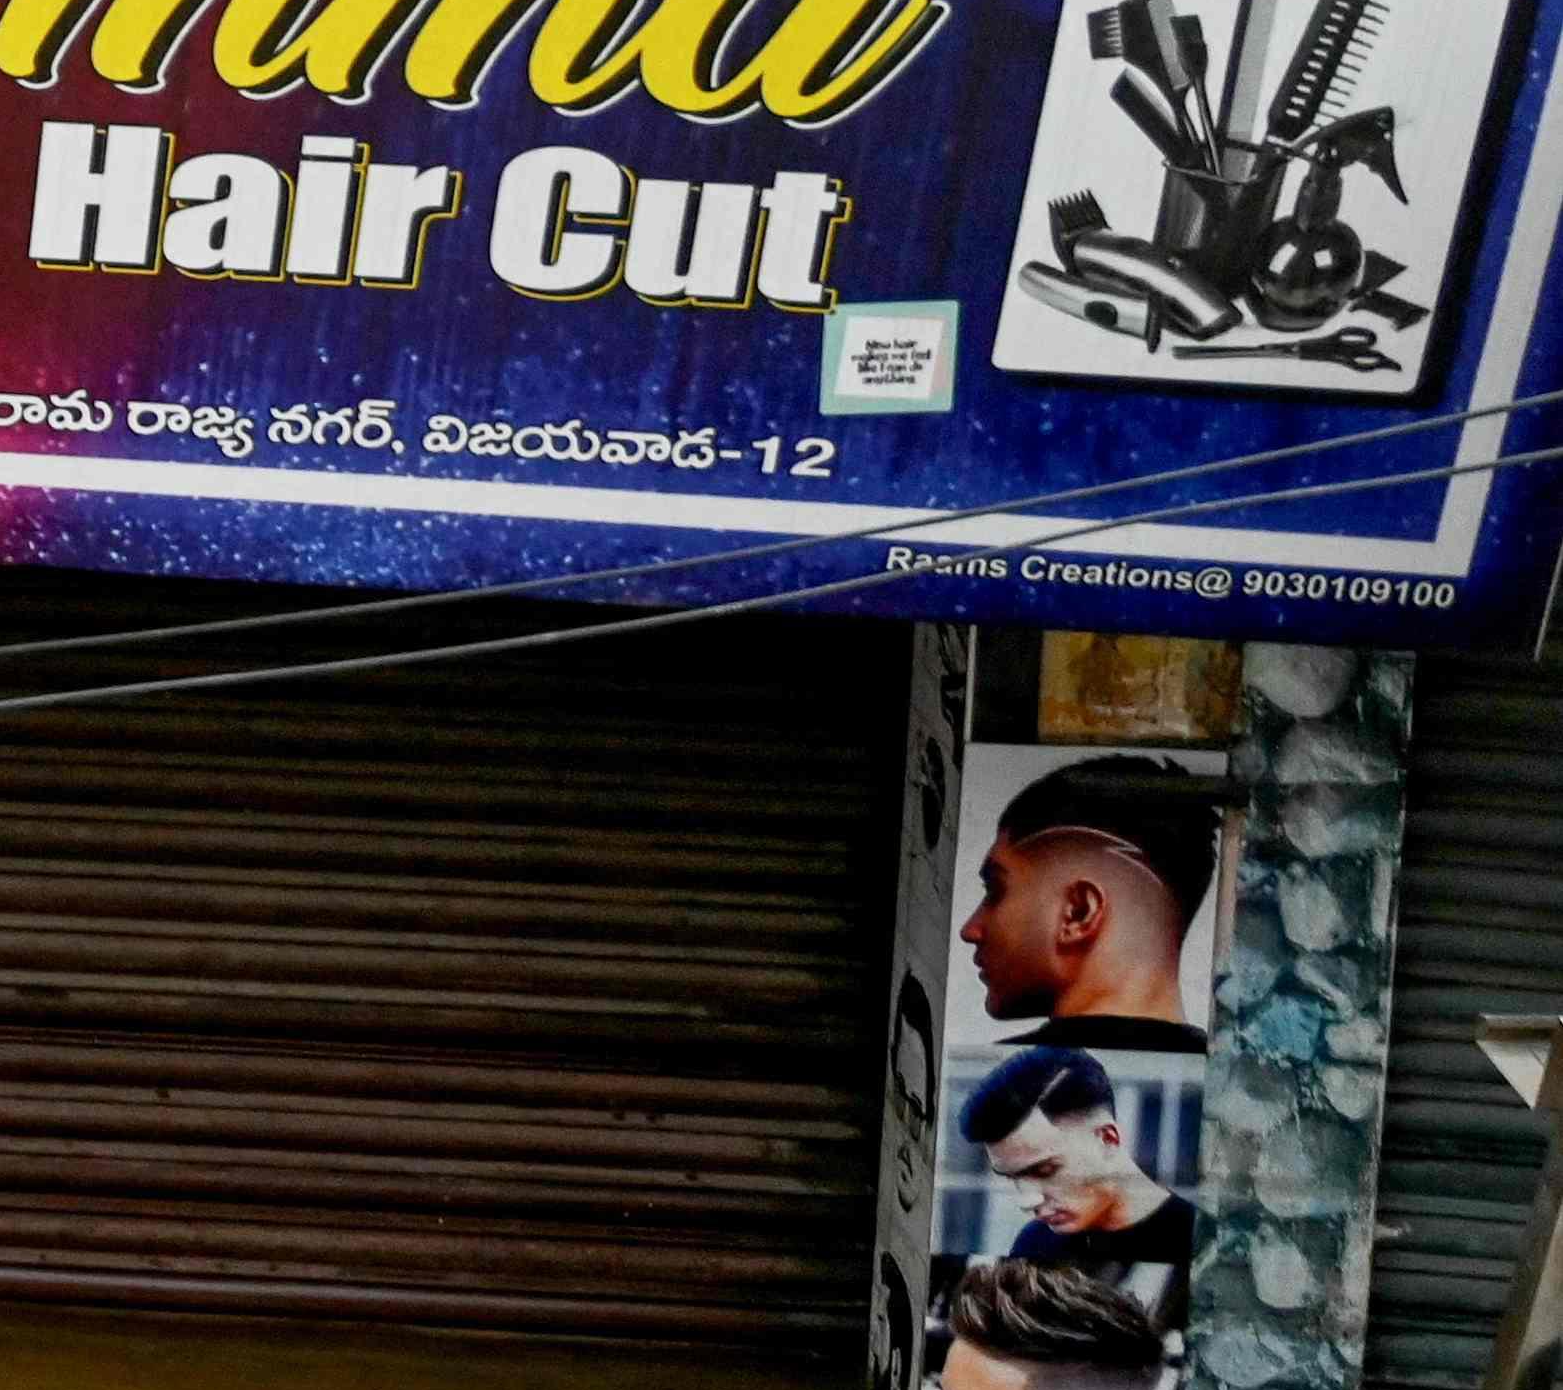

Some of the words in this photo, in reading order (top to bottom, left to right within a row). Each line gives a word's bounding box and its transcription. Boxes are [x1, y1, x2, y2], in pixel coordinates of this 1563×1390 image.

[26, 118, 461, 289] Hair
[486, 143, 852, 315] Cut
[126, 397, 254, 459] రాజ్య
[267, 398, 406, 455] నగర్,
[1242, 570, 1456, 610] 9030109100
